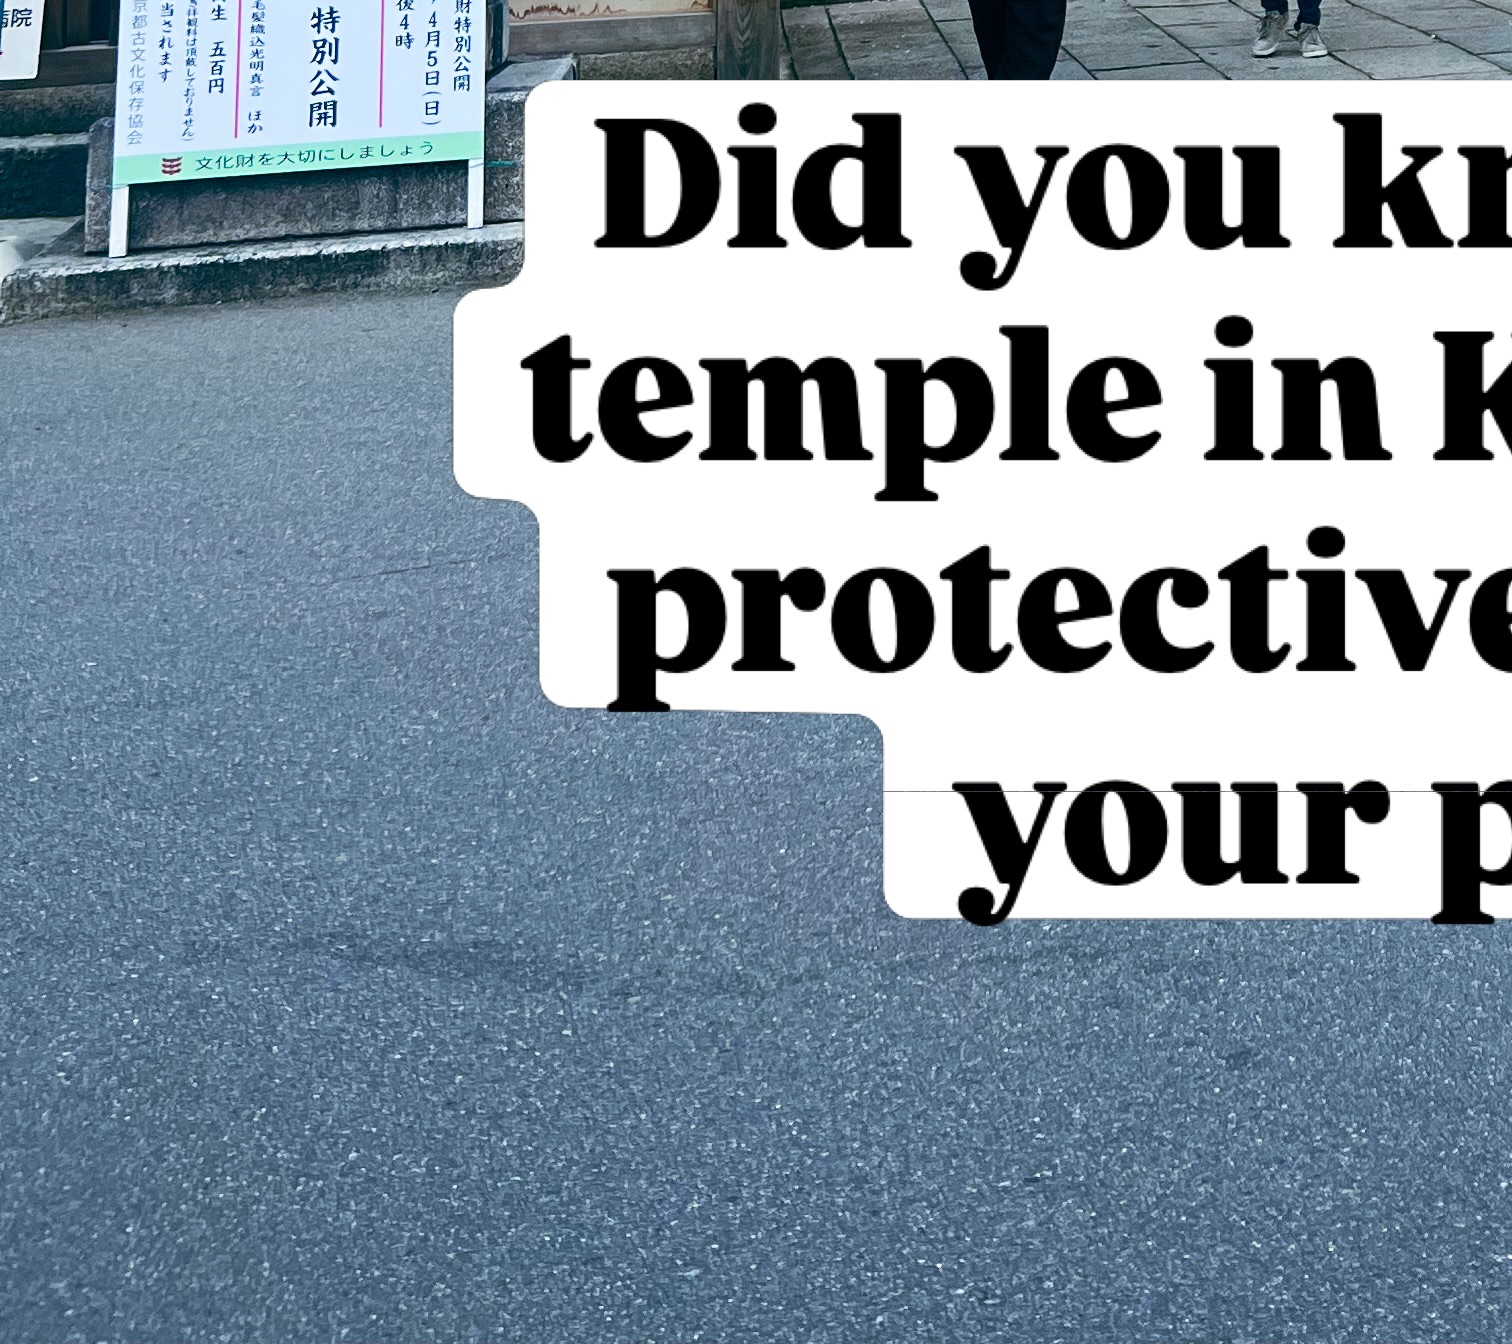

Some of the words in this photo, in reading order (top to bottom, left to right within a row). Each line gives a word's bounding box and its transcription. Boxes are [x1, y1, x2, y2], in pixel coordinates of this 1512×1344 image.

[208, 40, 227, 94] 五百円
[309, 6, 340, 128] 特別公開
[248, 110, 263, 134] ほか
[195, 141, 434, 170] 文化財を大切にしましょう
